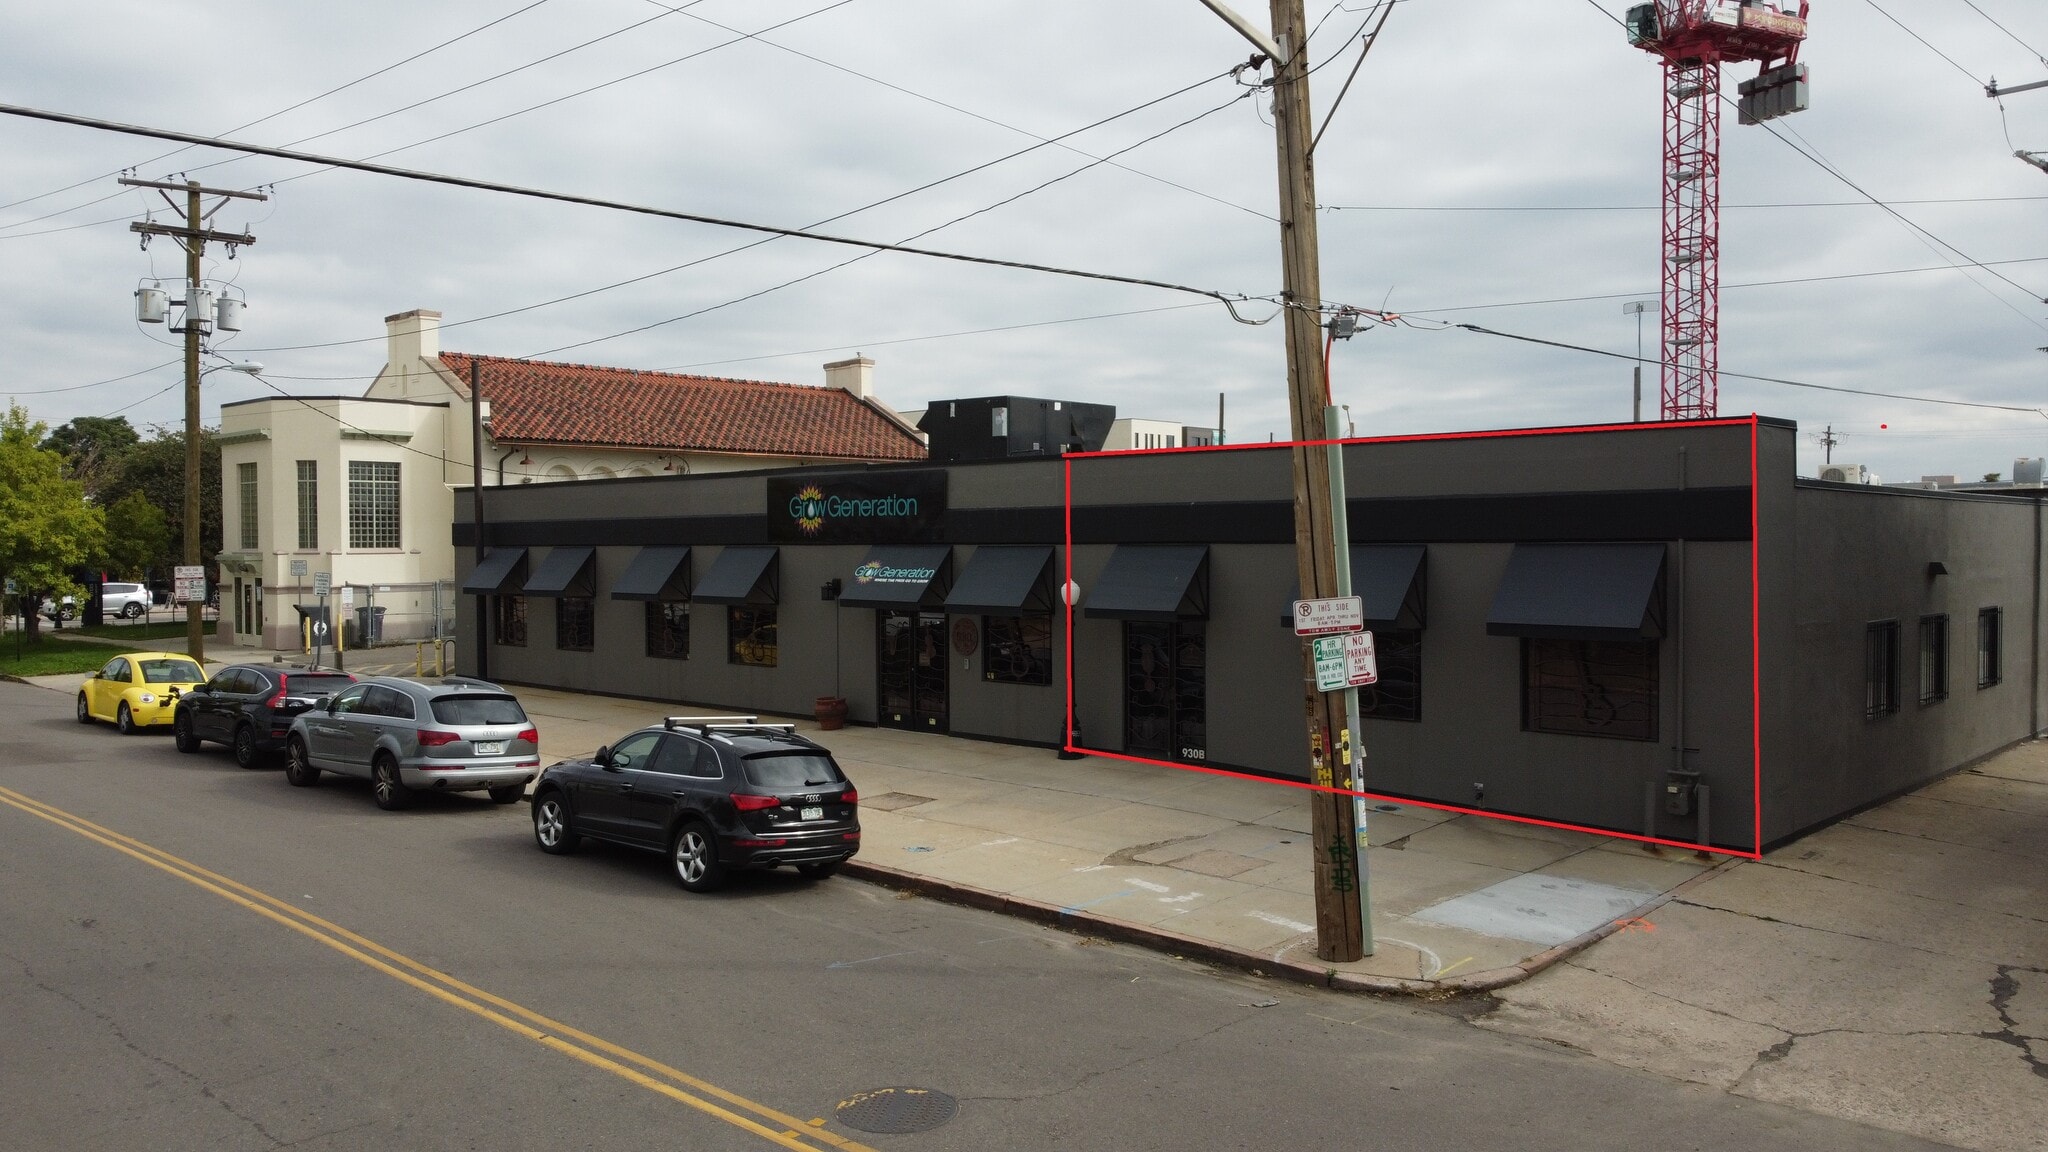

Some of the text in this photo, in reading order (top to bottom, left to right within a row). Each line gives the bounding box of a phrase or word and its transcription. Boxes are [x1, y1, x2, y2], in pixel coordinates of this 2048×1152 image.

[1318, 604, 1331, 612] THIS
[1352, 636, 1363, 646] NO
[1315, 640, 1336, 658] 2 HR
[1322, 648, 1343, 658] PARKING
[1347, 647, 1371, 659] PARKING
[1354, 664, 1367, 672] TIME
[1182, 748, 1205, 759] 930B
